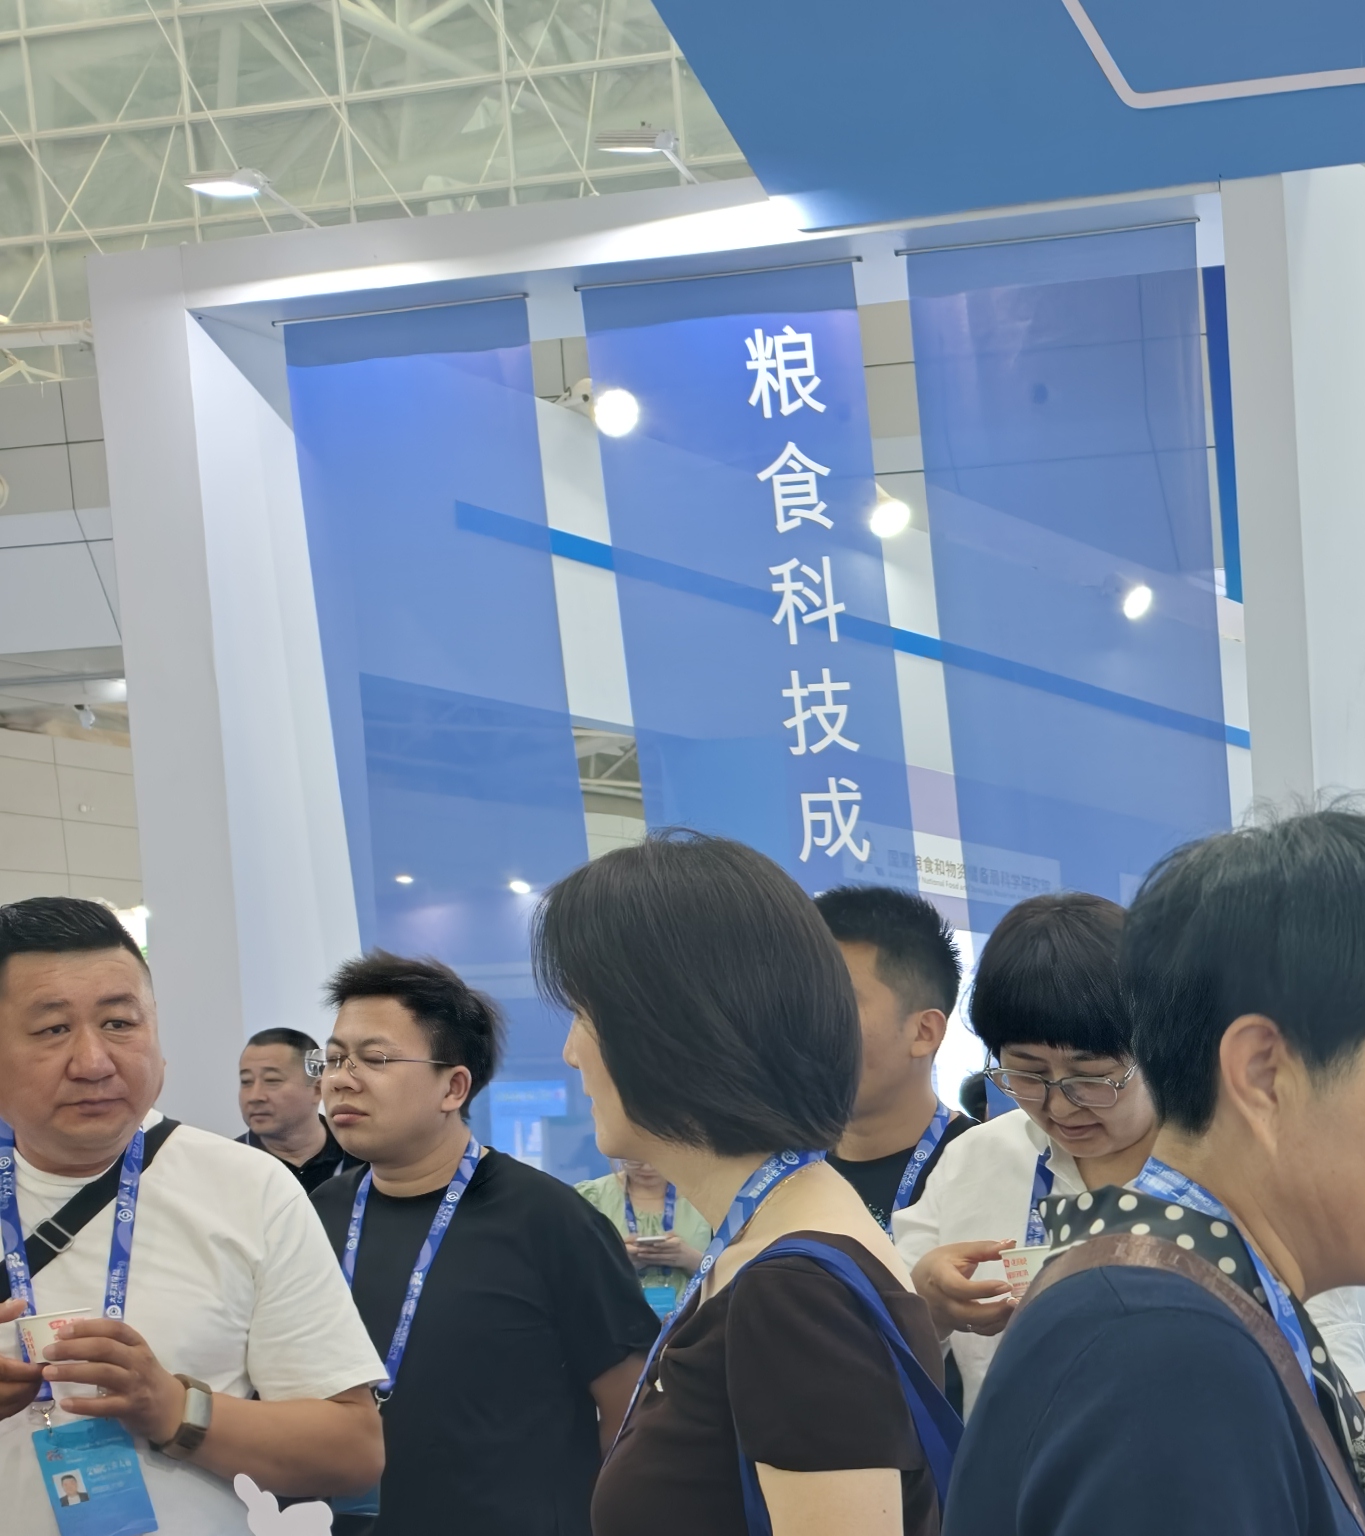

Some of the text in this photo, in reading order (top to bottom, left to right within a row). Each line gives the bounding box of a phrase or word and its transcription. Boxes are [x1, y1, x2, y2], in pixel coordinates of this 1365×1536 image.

[744, 325, 871, 863] 粮食科技成
